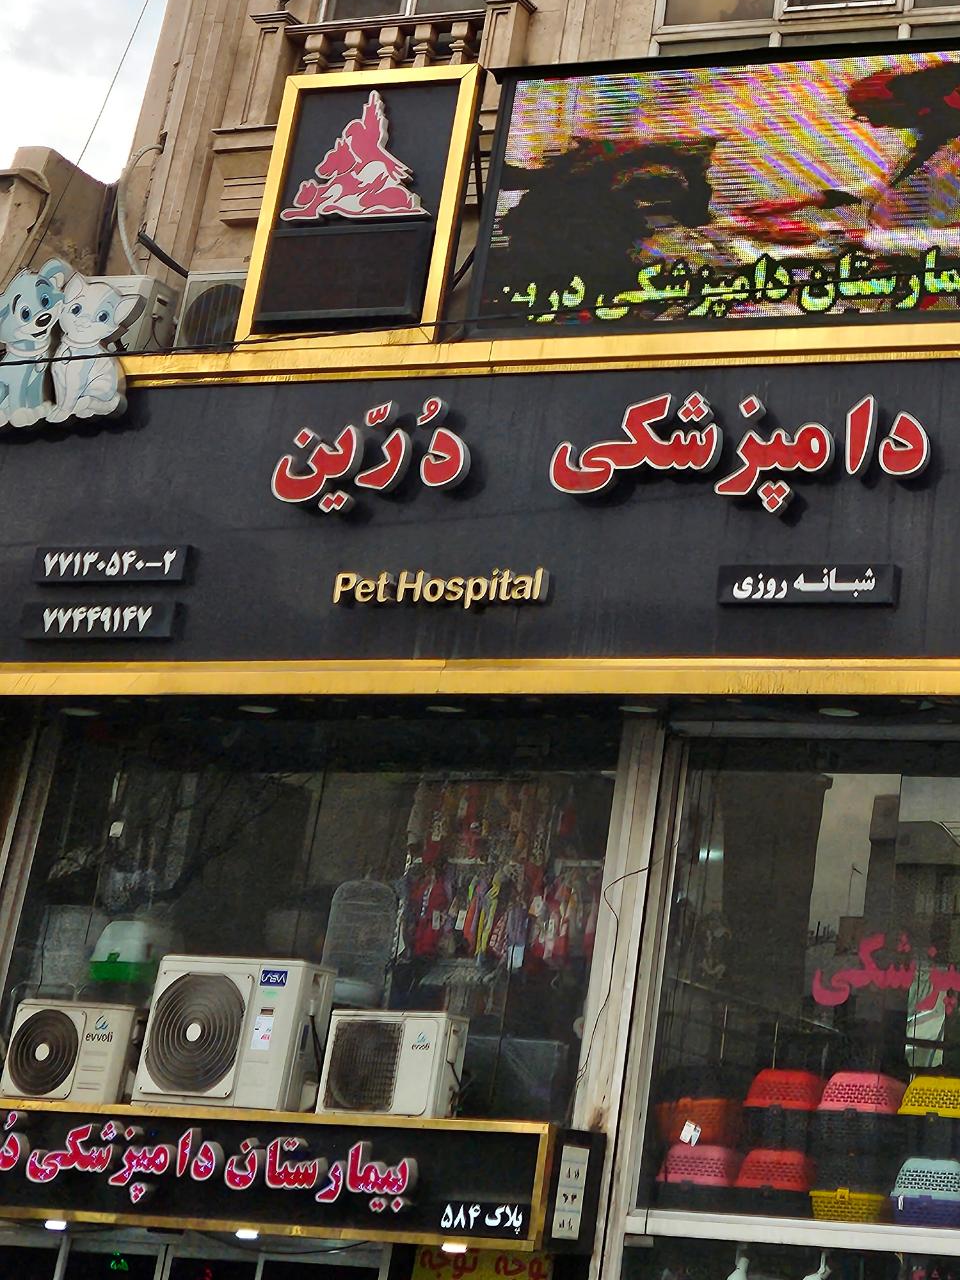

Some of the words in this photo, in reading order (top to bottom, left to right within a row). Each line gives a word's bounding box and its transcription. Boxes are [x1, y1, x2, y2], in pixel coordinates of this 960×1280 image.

[596, 257, 790, 320] دامپزشکی
[549, 391, 930, 513] دامپزشکی
[332, 571, 389, 604] Pet
[396, 567, 545, 609] Hospital
[732, 572, 788, 599] روزی
[793, 567, 876, 597] شبانه
[43, 605, 153, 633] ۷۷۴۴۹۱۴۷
[85, 1031, 114, 1042] evvoli
[26, 1120, 216, 1204] دامپزشکی
[225, 1137, 410, 1213] بیمارستان
[440, 1203, 481, 1230] ۵۸۴
[484, 1204, 523, 1235] پلاک
